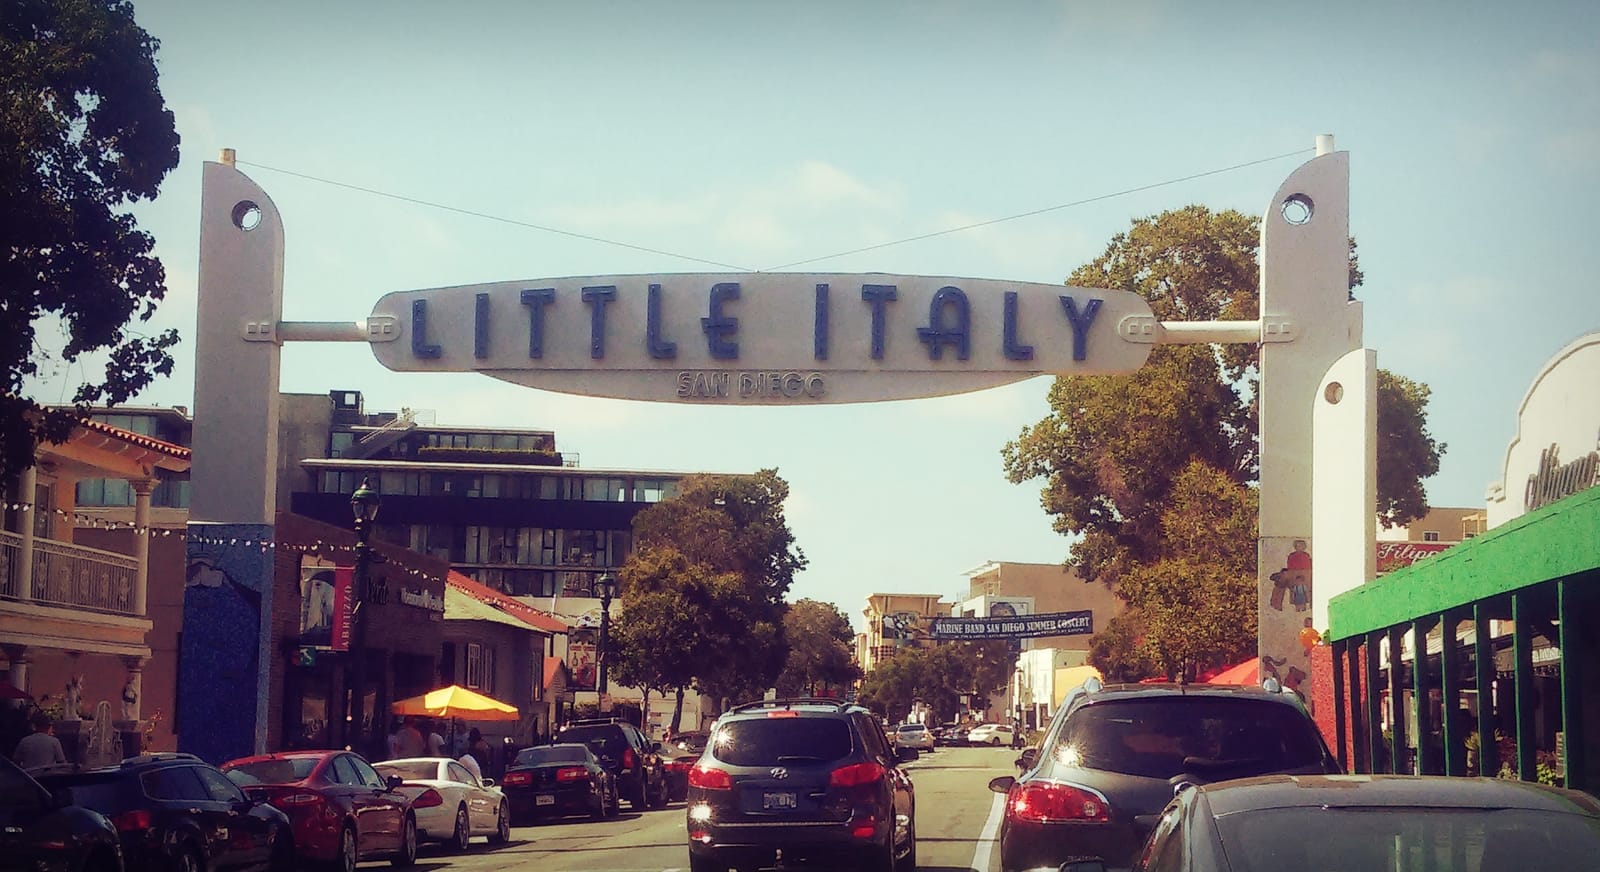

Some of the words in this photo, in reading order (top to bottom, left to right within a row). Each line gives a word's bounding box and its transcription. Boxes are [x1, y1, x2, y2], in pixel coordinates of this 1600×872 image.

[411, 283, 741, 360] LITTLE
[814, 283, 1105, 361] ITALY
[676, 371, 730, 398] SAN
[738, 371, 825, 398] DIEGO
[341, 584, 353, 648] ABRUZZO
[935, 623, 963, 634] MARINE
[964, 623, 985, 634] BAND
[986, 622, 1000, 633] SAN
[1001, 621, 1025, 633] DIEGO
[1026, 619, 1056, 631] SUMMER
[1057, 616, 1090, 629] CONCERT
